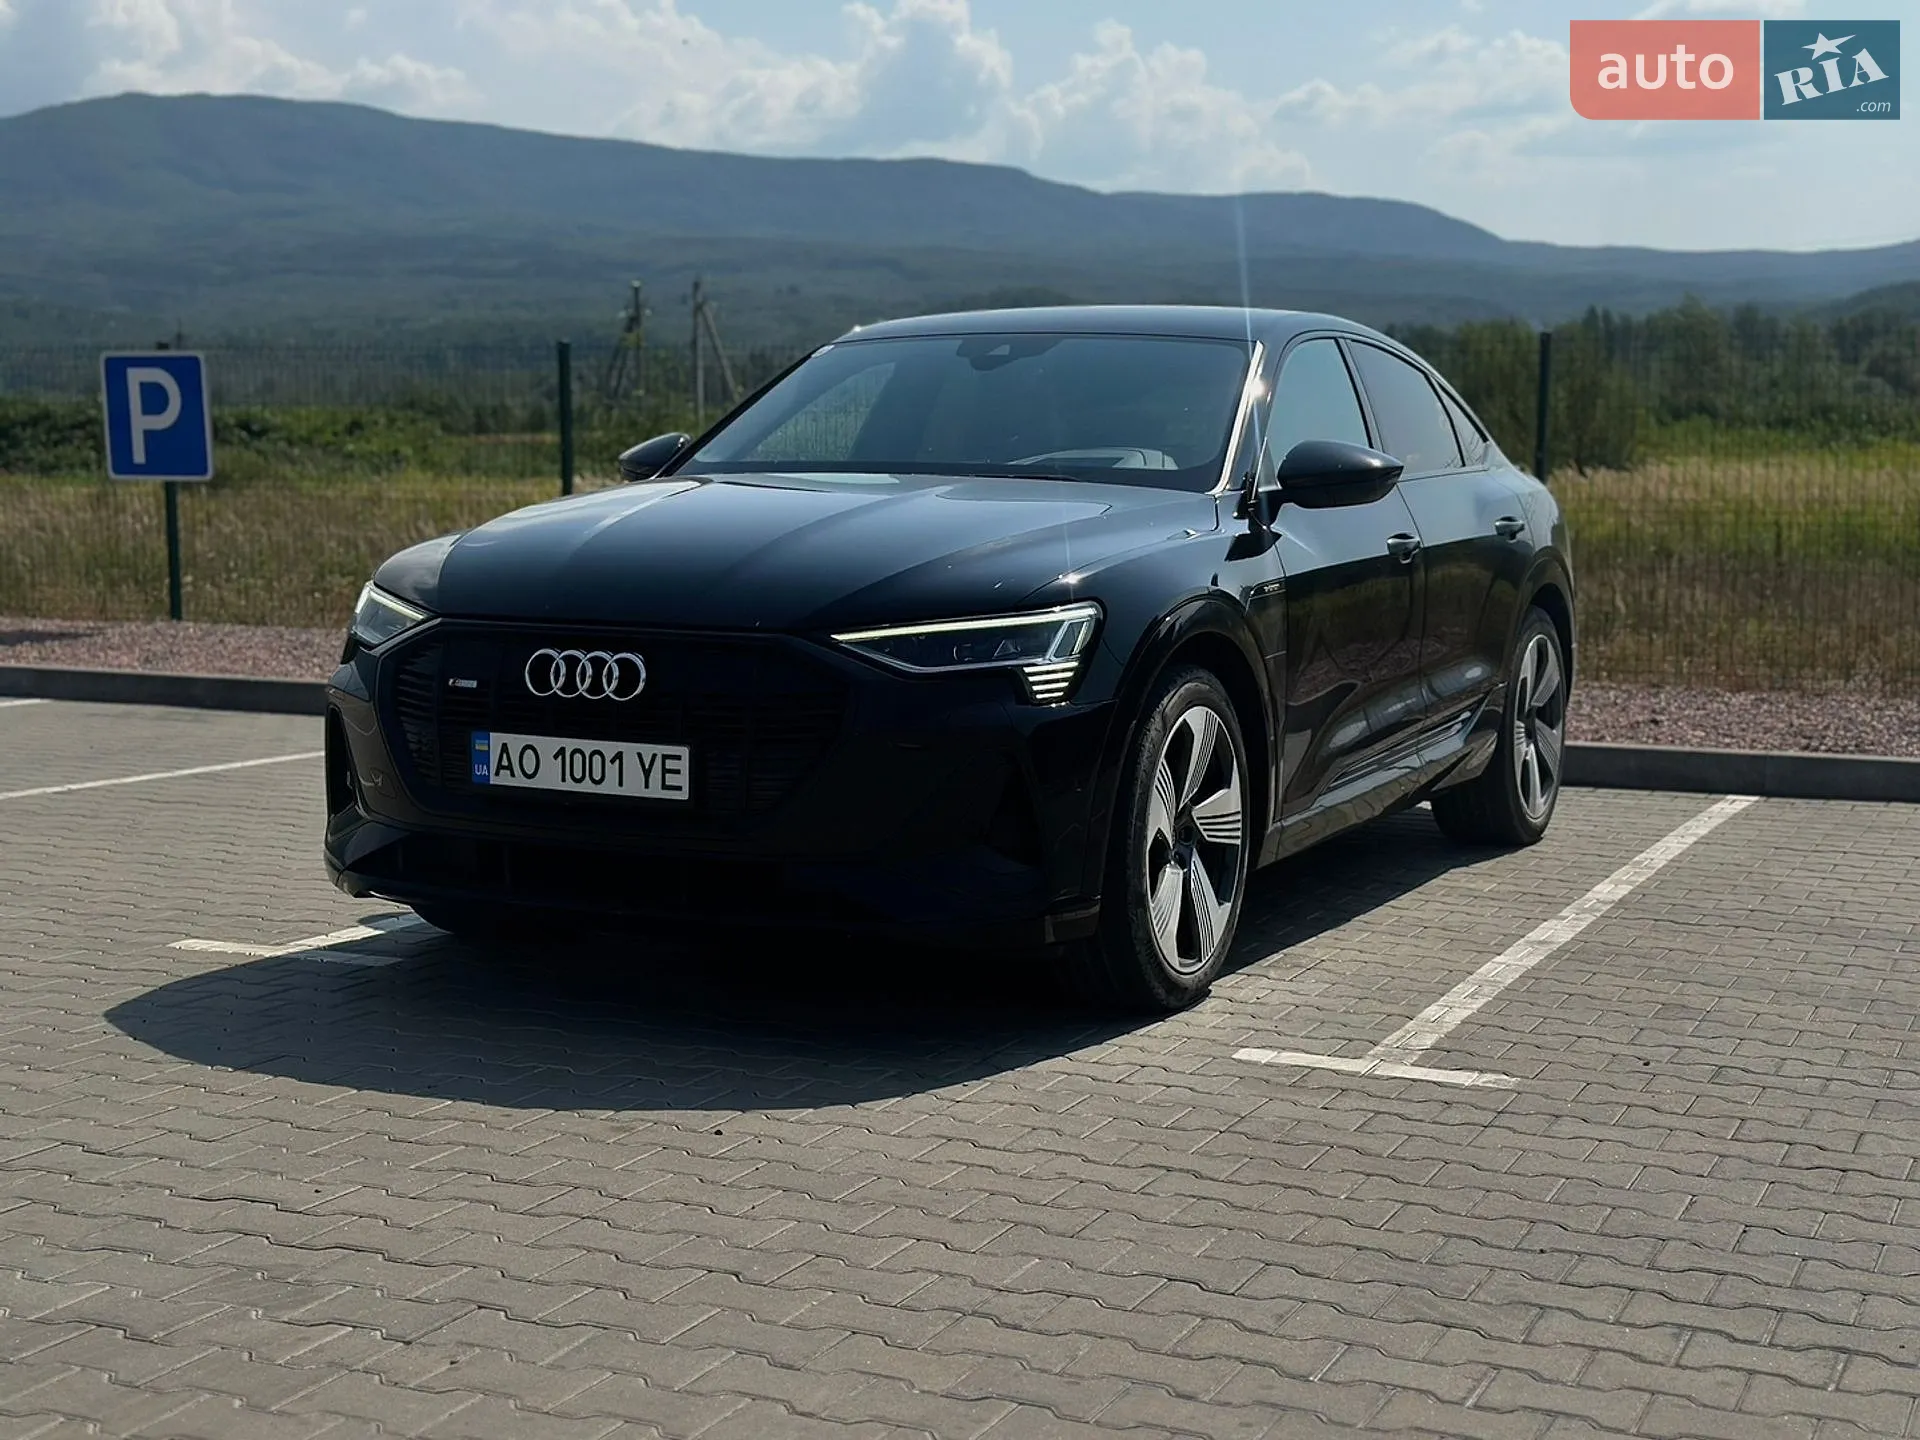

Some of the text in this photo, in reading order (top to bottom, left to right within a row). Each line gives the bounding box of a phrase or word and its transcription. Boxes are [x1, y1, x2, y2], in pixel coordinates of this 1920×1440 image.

[126, 367, 182, 464] P
[475, 764, 488, 776] UA
[494, 743, 683, 791] AO 1001 YE
